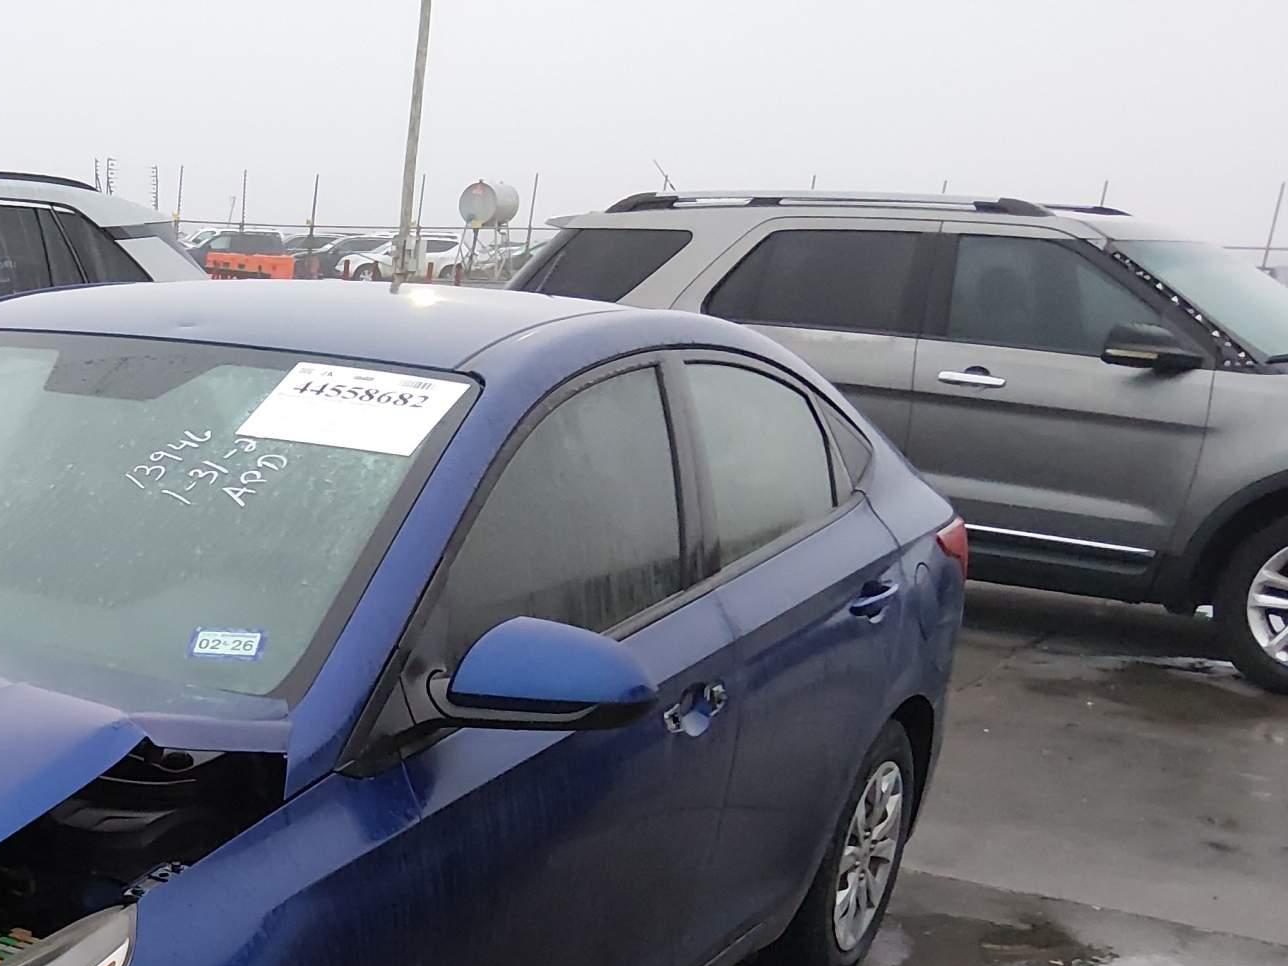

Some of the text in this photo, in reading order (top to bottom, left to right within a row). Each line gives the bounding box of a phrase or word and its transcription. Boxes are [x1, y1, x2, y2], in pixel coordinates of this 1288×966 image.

[293, 380, 429, 408] 44558682
[198, 638, 254, 652] 02 26
